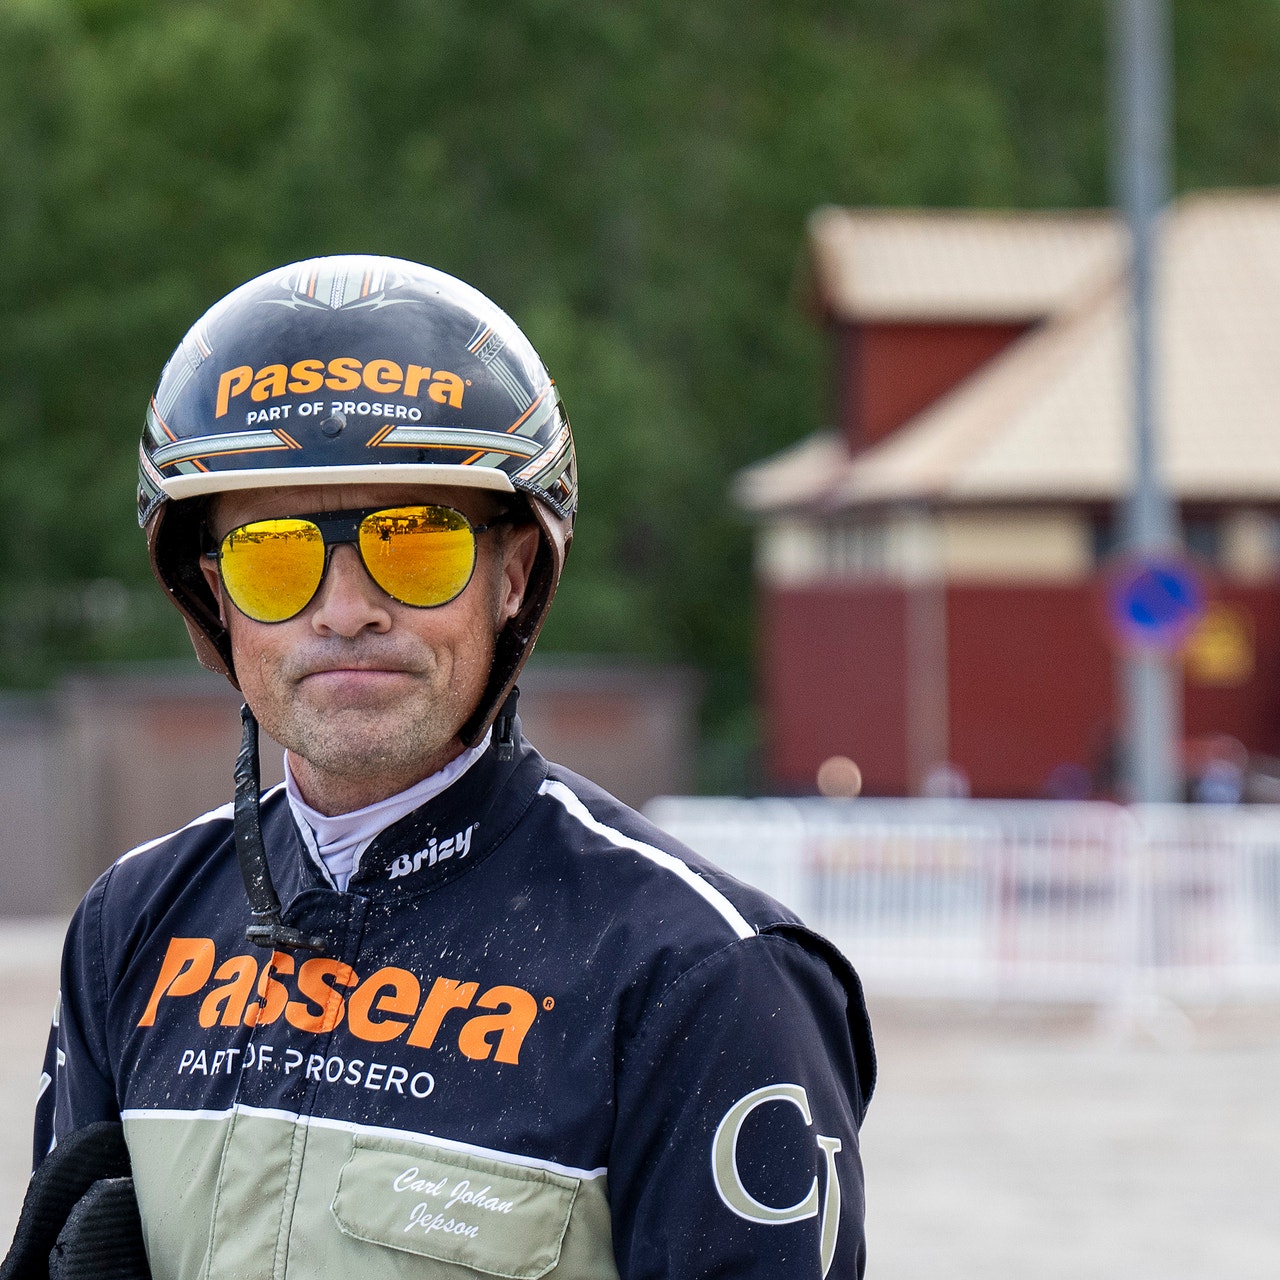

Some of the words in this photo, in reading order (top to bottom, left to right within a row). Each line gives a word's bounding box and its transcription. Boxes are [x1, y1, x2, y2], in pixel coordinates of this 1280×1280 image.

[215, 357, 466, 419] Passera
[247, 404, 292, 425] PART
[298, 401, 324, 416] OF
[331, 401, 422, 421] PROSERO
[385, 825, 474, 880] Brizy
[137, 937, 538, 1065] Passera
[177, 1049, 240, 1076] PART
[284, 1048, 435, 1099] PROSERO
[393, 1166, 443, 1197] Carl
[444, 1179, 513, 1214] Johan
[404, 1202, 479, 1238] Jepson
